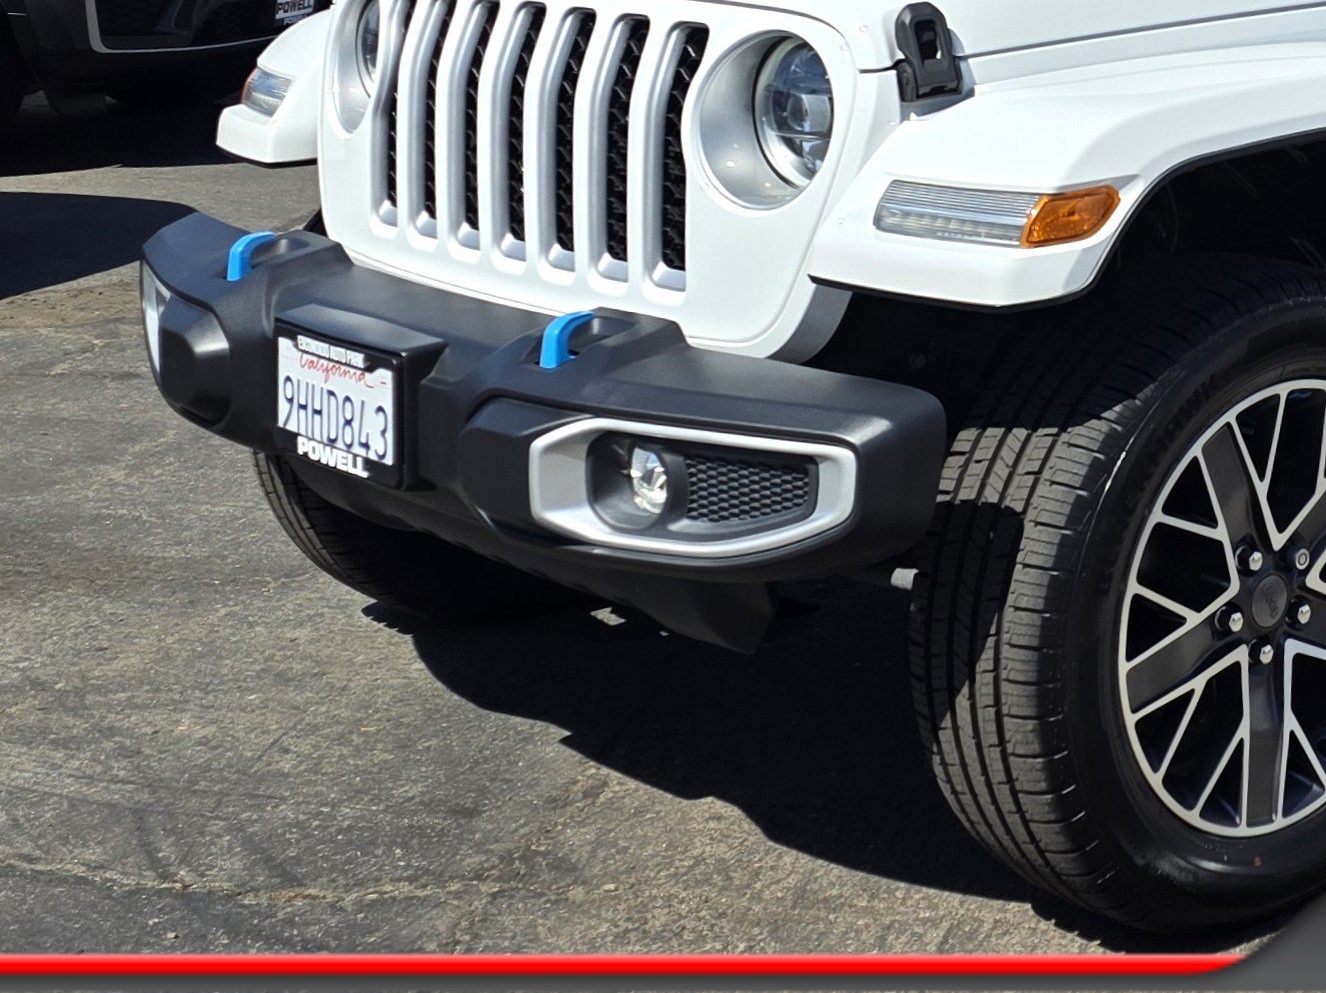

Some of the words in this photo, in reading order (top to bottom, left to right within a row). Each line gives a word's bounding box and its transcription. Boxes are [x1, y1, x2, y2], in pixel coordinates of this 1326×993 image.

[300, 352, 375, 389] California
[283, 375, 388, 462] 9HHD843
[297, 435, 370, 479] POWELL
